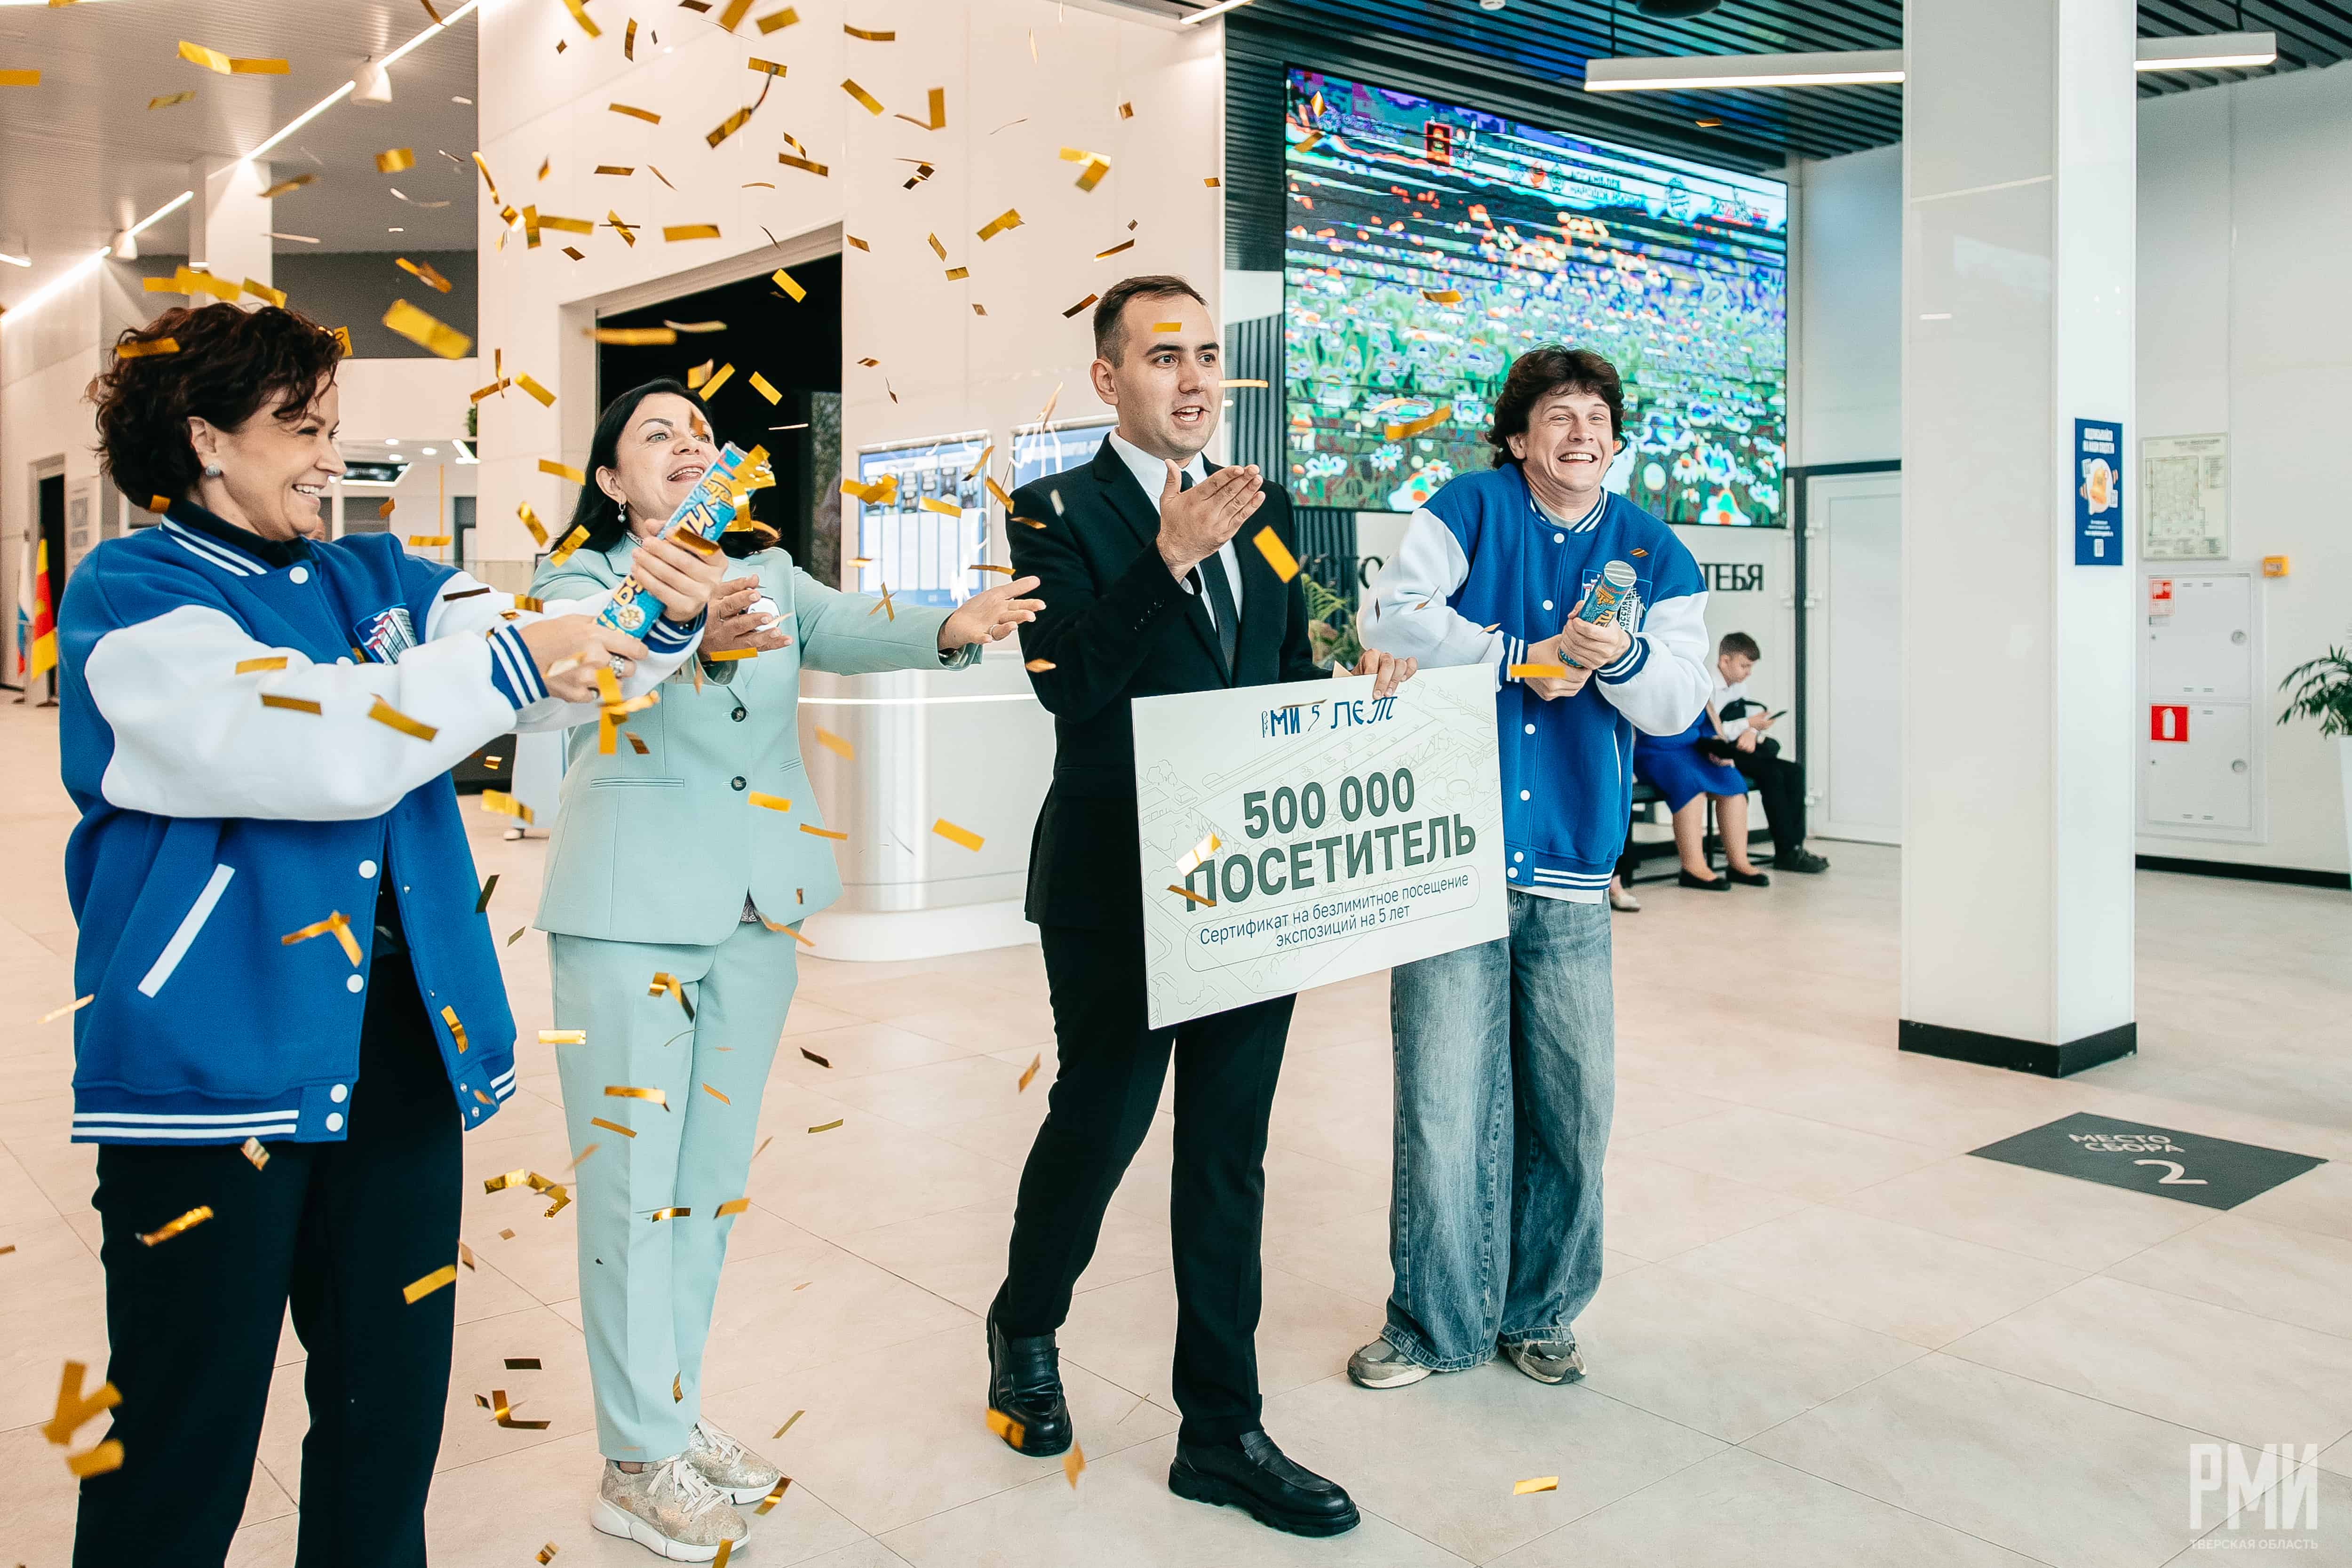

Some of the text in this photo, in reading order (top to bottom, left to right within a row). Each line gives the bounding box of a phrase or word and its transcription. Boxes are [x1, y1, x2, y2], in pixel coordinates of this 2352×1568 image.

[1699, 563, 1763, 591] ТЕБЯ
[1619, 601, 1629, 629] ОССИЯ
[1308, 705, 1320, 732] 5
[1243, 768, 1414, 839] 500 000
[1185, 813, 1476, 912] ПОСЕТИТЕЛЬ
[1200, 874, 1469, 946] Сертификат на безлимитное посещение
[1276, 905, 1411, 947] экспозиций на 5 лет
[2069, 1134, 2171, 1144] МЕСТО
[2084, 1142, 2186, 1153] СБОРА
[2133, 1159, 2209, 1185] 2
